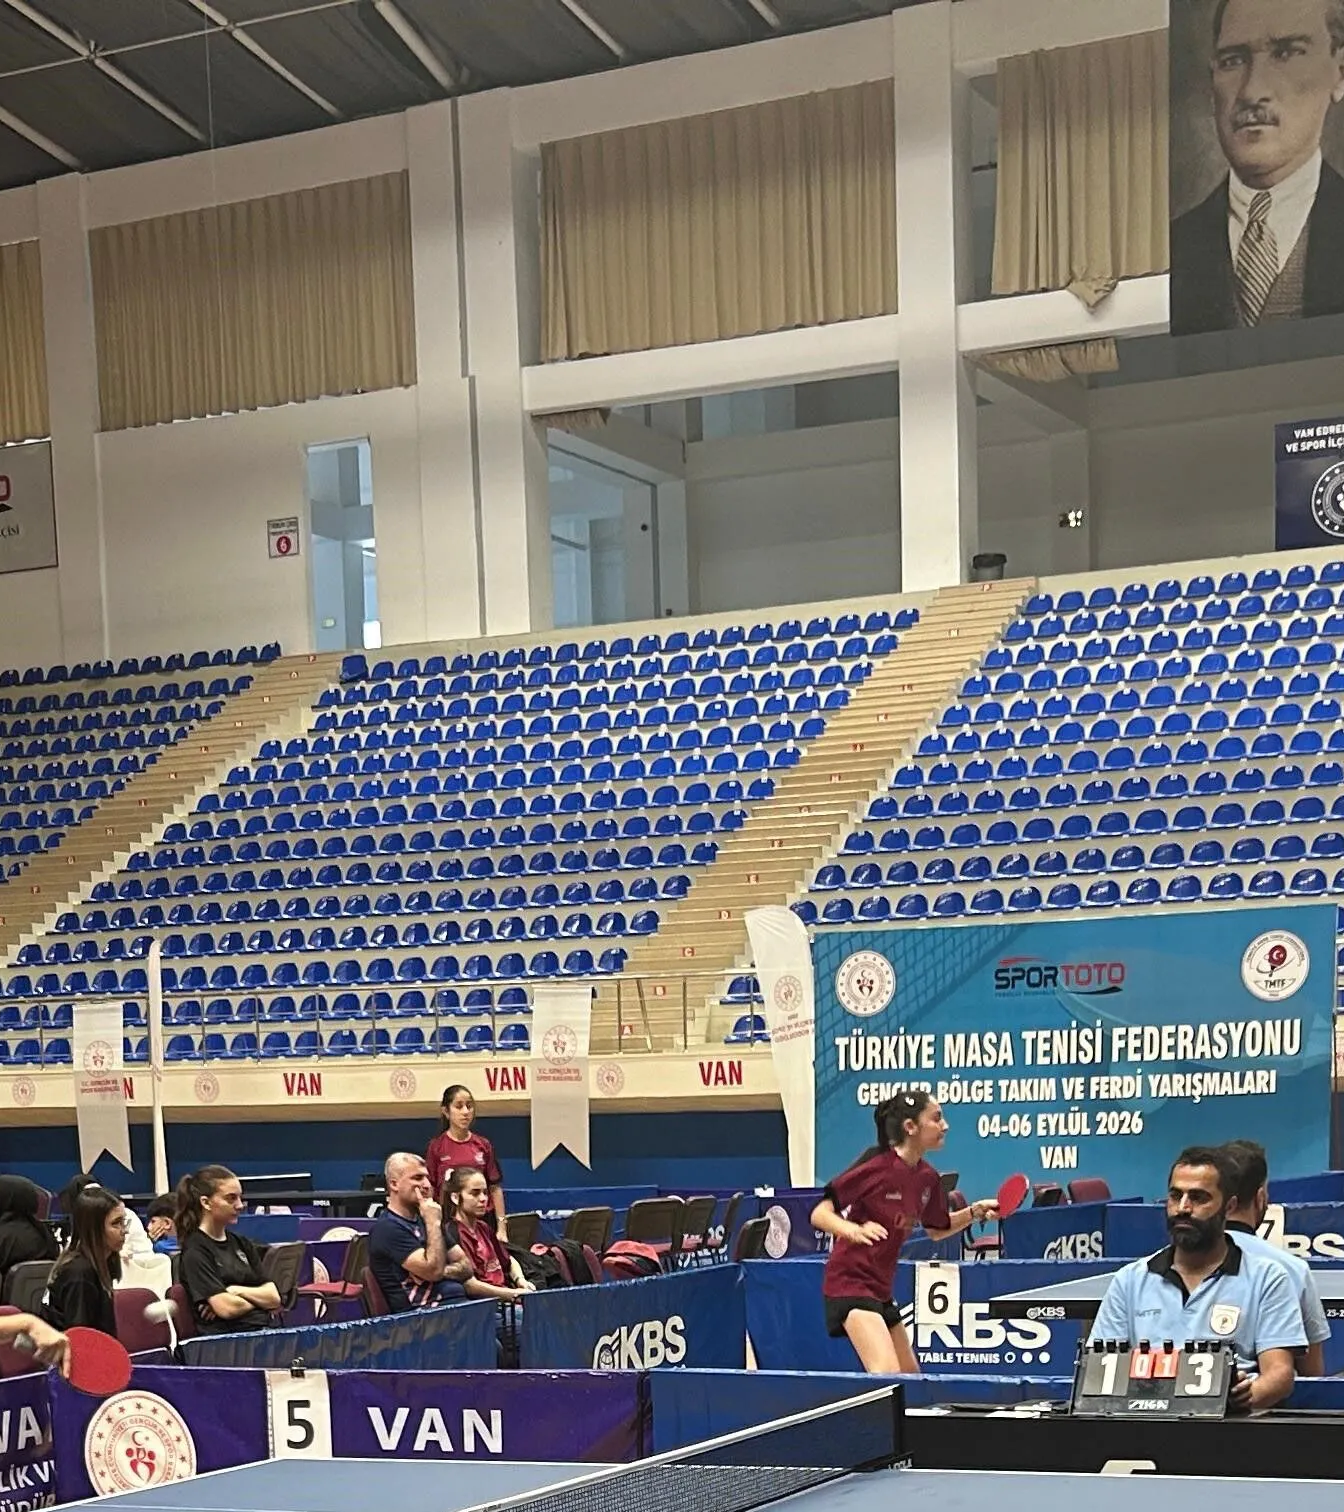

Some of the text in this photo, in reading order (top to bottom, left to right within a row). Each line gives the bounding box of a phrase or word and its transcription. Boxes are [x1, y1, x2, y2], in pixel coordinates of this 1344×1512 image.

[1285, 442, 1299, 453] VE
[1300, 439, 1326, 451] SPOR
[1294, 427, 1315, 439] VAN
[994, 962, 1126, 990] SPORTOTO
[835, 1026, 936, 1071] TÜRKİYE
[944, 1031, 1014, 1068] MASA
[1022, 1020, 1103, 1066] TENİSİ
[1112, 1018, 1301, 1063] FEDERASYONU
[283, 1073, 322, 1097] VAN
[485, 1066, 527, 1092] VAN
[699, 1060, 743, 1087] VAN
[938, 1074, 994, 1104] BÖLGE
[998, 1078, 1057, 1102] TAKIM
[1062, 1076, 1085, 1101] VE
[1090, 1068, 1142, 1100] FERDİ
[1148, 1070, 1277, 1104] YARIŞMALARI
[978, 1107, 1143, 1138] 04-06 EYLÜL 2026
[1040, 1146, 1078, 1169] VAN
[1060, 1231, 1104, 1260] KBS
[927, 1281, 949, 1315] 6
[1037, 1305, 1066, 1318] KBS
[619, 1315, 686, 1370] KBS
[918, 1352, 1000, 1364] TABLE TENNIS
[1101, 1353, 1119, 1396] 1
[1184, 1353, 1214, 1396] 3
[287, 1399, 314, 1450] 5
[367, 1404, 504, 1454] VAN
